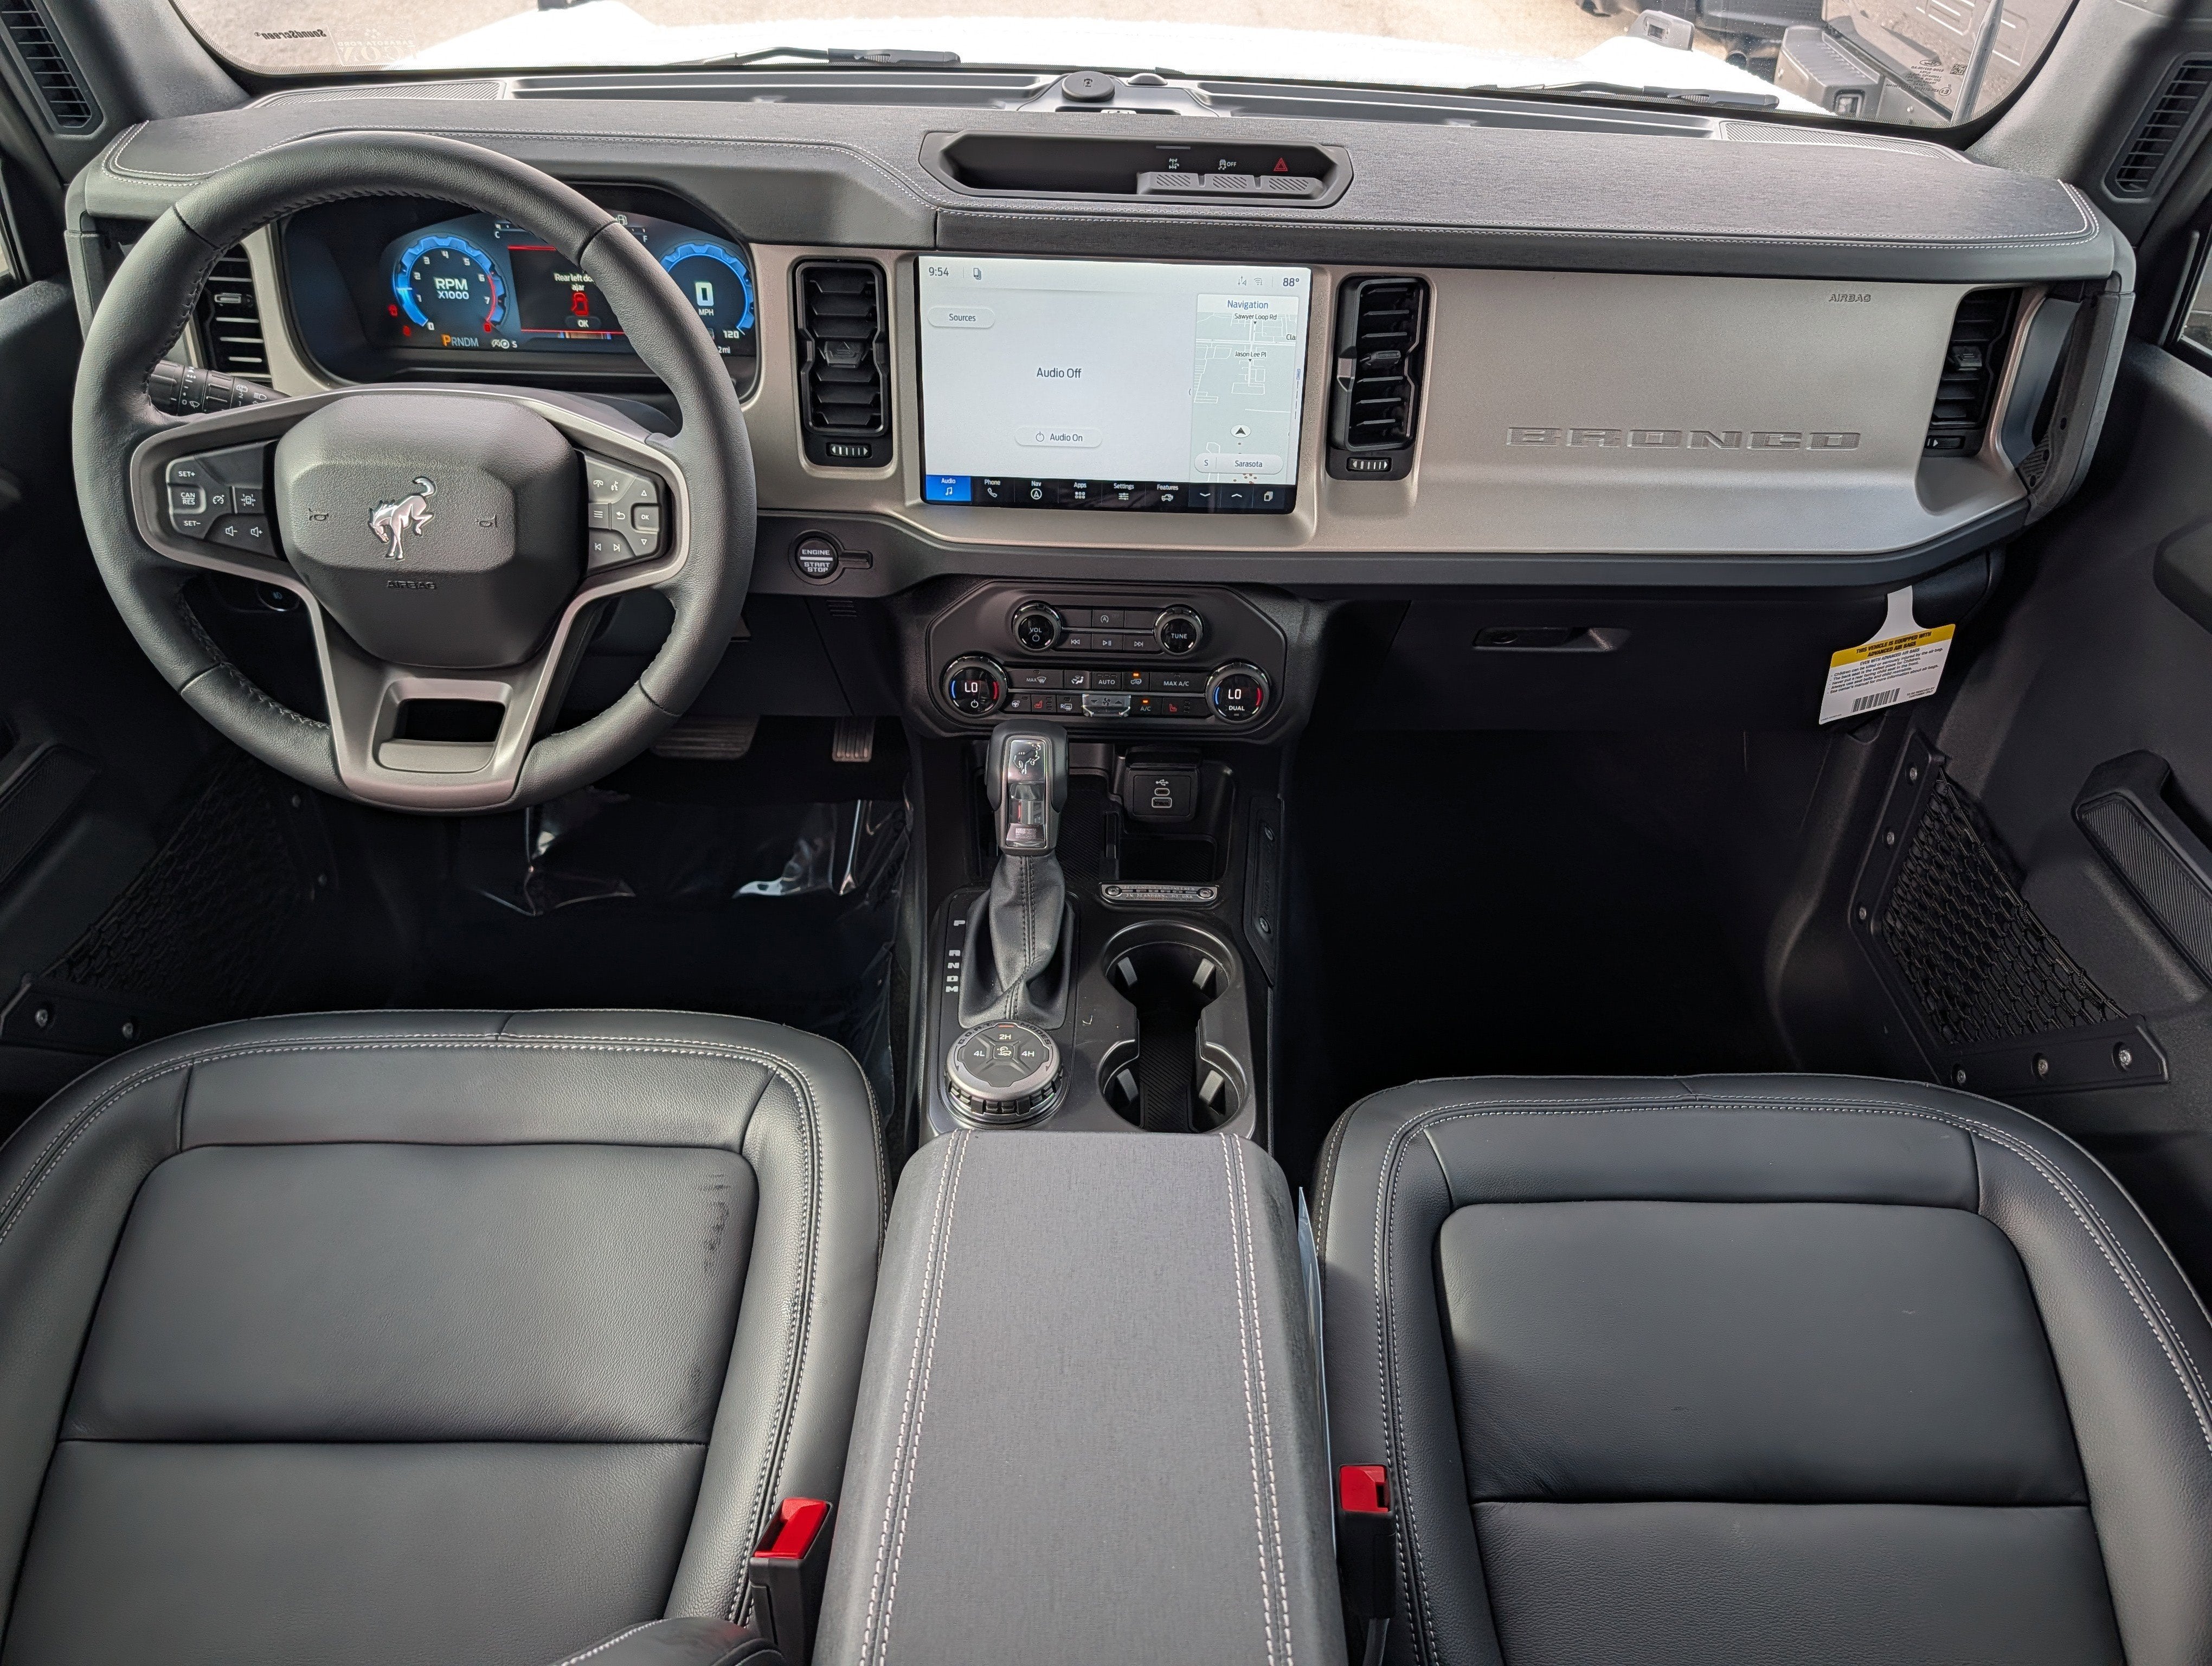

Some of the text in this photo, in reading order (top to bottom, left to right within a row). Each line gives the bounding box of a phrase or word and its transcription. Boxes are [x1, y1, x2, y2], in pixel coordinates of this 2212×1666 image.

[441, 250, 449, 259] 4
[422, 255, 430, 265] 3
[463, 257, 470, 266] 5
[413, 271, 421, 280] 2
[928, 267, 949, 277] 9:54
[478, 273, 485, 282] 6
[554, 273, 570, 282] Rear
[570, 273, 583, 282] left
[434, 277, 468, 290] RPM
[571, 284, 585, 292] ajar
[416, 293, 422, 302] 1
[437, 290, 470, 300] X1000
[695, 282, 714, 306] 0
[1828, 293, 1872, 302] AIRBAG
[484, 296, 490, 304] 7
[1227, 300, 1269, 310] Navigation
[949, 313, 976, 322] Sources
[426, 322, 434, 331] 0
[577, 319, 589, 328] OK
[722, 330, 740, 339] 120
[1037, 367, 1082, 379] Audio Off
[1050, 433, 1083, 442] Audio On
[1507, 427, 1861, 450] BRONCO
[1868, 642, 1888, 651] VEHICLE
[1894, 635, 1918, 644] EQUIPPED
[1867, 647, 1893, 657] ADVANCED
[965, 682, 978, 693] LO
[1228, 689, 1241, 699] LO
[1020, 1022, 1051, 1045] MODES
